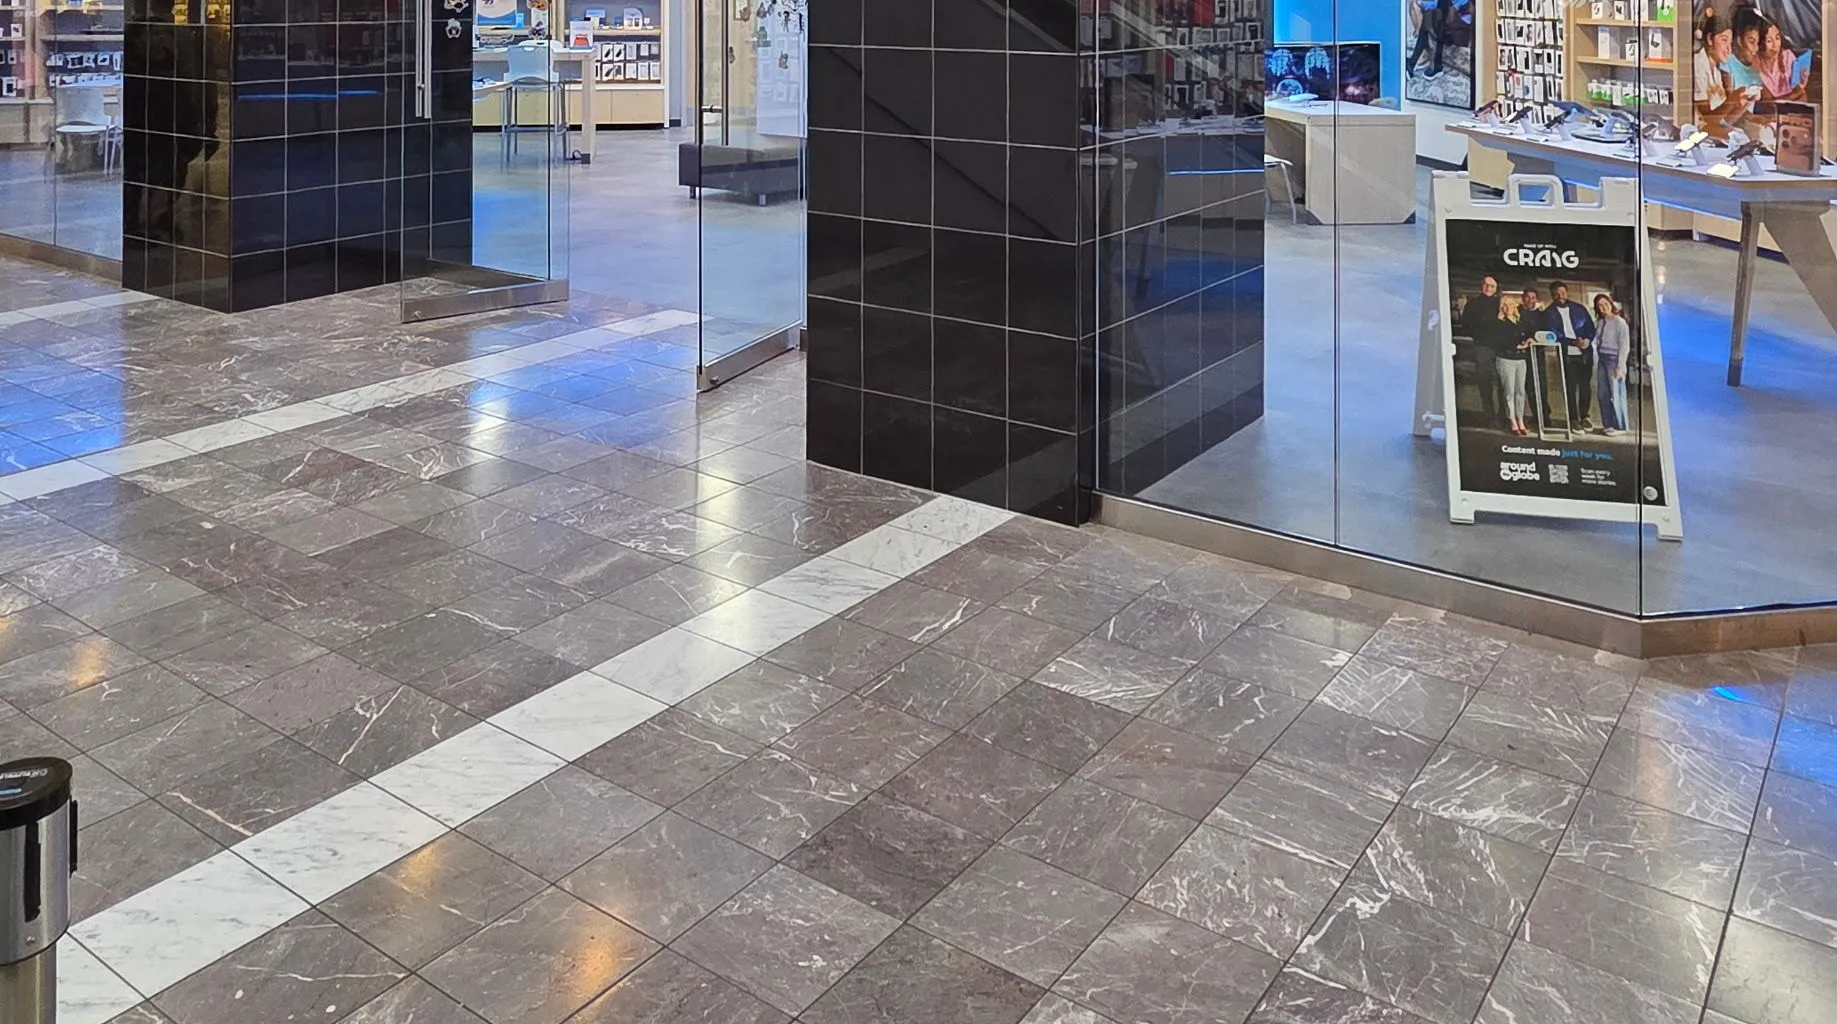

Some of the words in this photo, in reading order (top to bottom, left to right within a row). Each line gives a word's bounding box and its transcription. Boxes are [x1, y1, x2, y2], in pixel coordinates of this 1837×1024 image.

[1503, 248, 1580, 269] CRAIG
[1501, 444, 1536, 456] Content
[1537, 447, 1561, 457] made
[1561, 448, 1579, 460] just
[1580, 449, 1593, 459] for
[1500, 461, 1537, 472] around
[1511, 469, 1541, 482] globe
